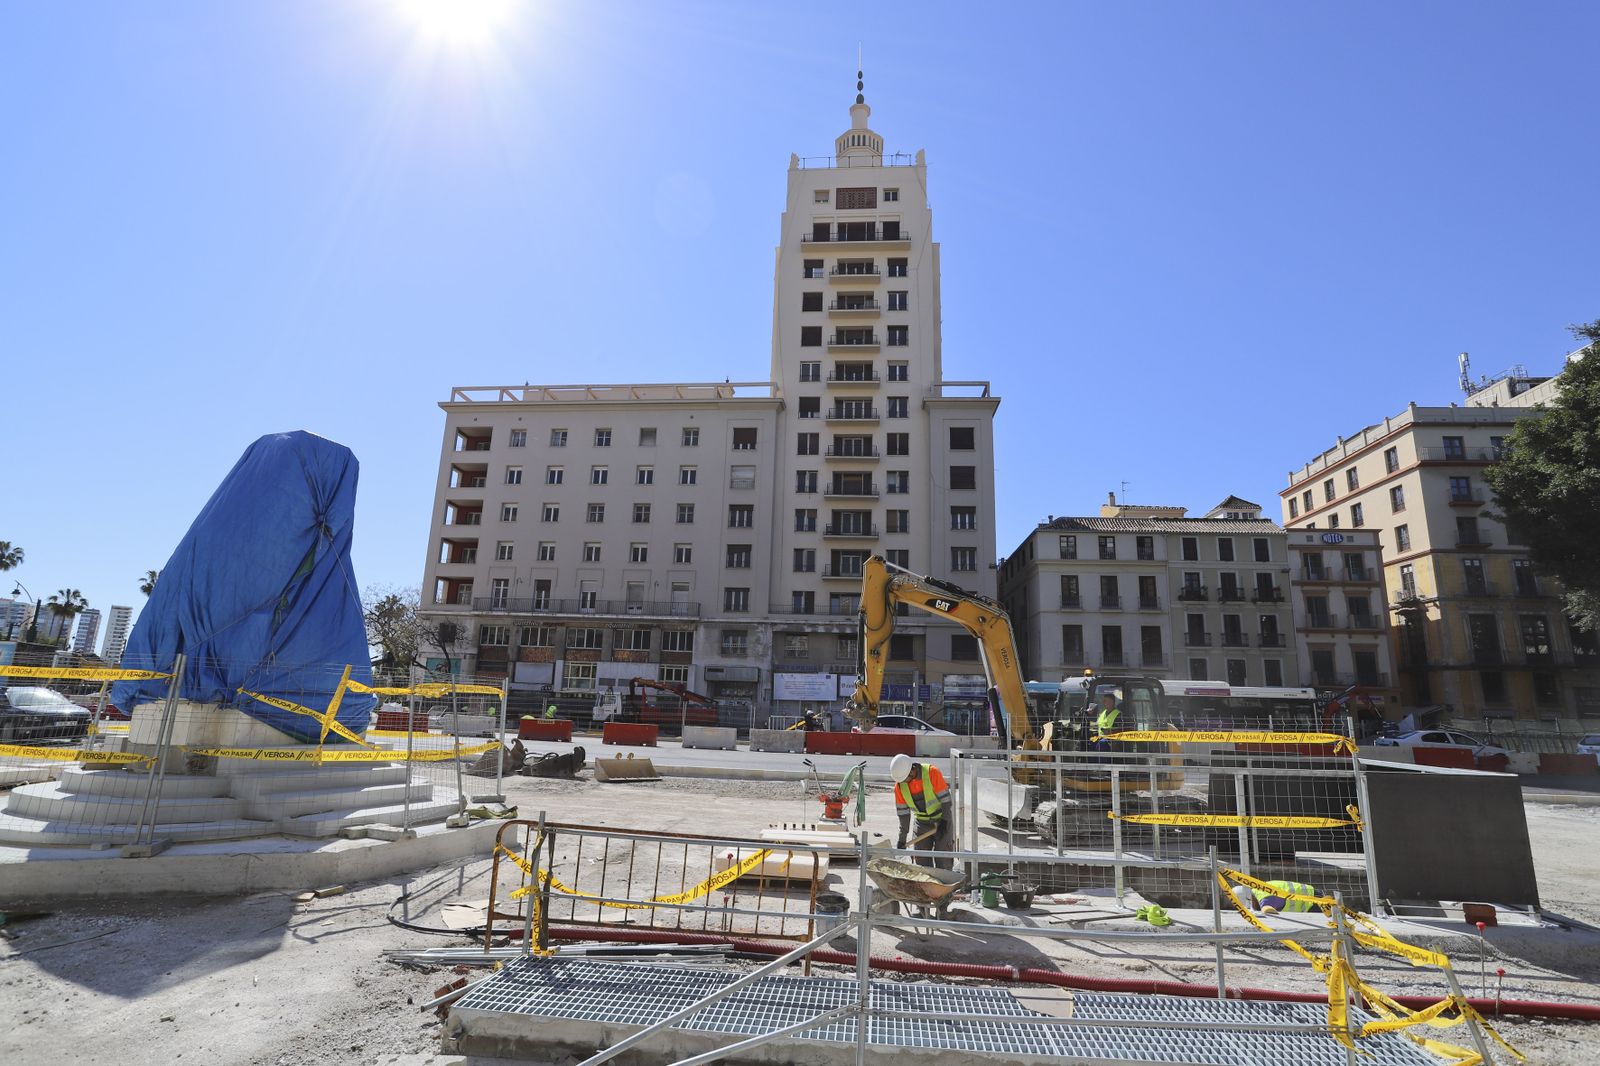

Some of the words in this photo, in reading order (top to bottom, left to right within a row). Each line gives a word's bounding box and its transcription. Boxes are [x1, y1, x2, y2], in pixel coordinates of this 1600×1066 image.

[1323, 533, 1342, 543] HOTEL
[935, 600, 950, 612] CAT
[1000, 647, 1010, 669] VEROSA
[7, 667, 32, 675] VEROSA
[22, 748, 46, 757] VEROSA
[82, 752, 106, 760] VEROSA
[264, 751, 295, 759] VEROSA
[700, 870, 735, 891] VEROSA
[743, 857, 754, 868] NO
[1237, 876, 1278, 897] VEROSA
[1229, 897, 1262, 931] VEROSA
